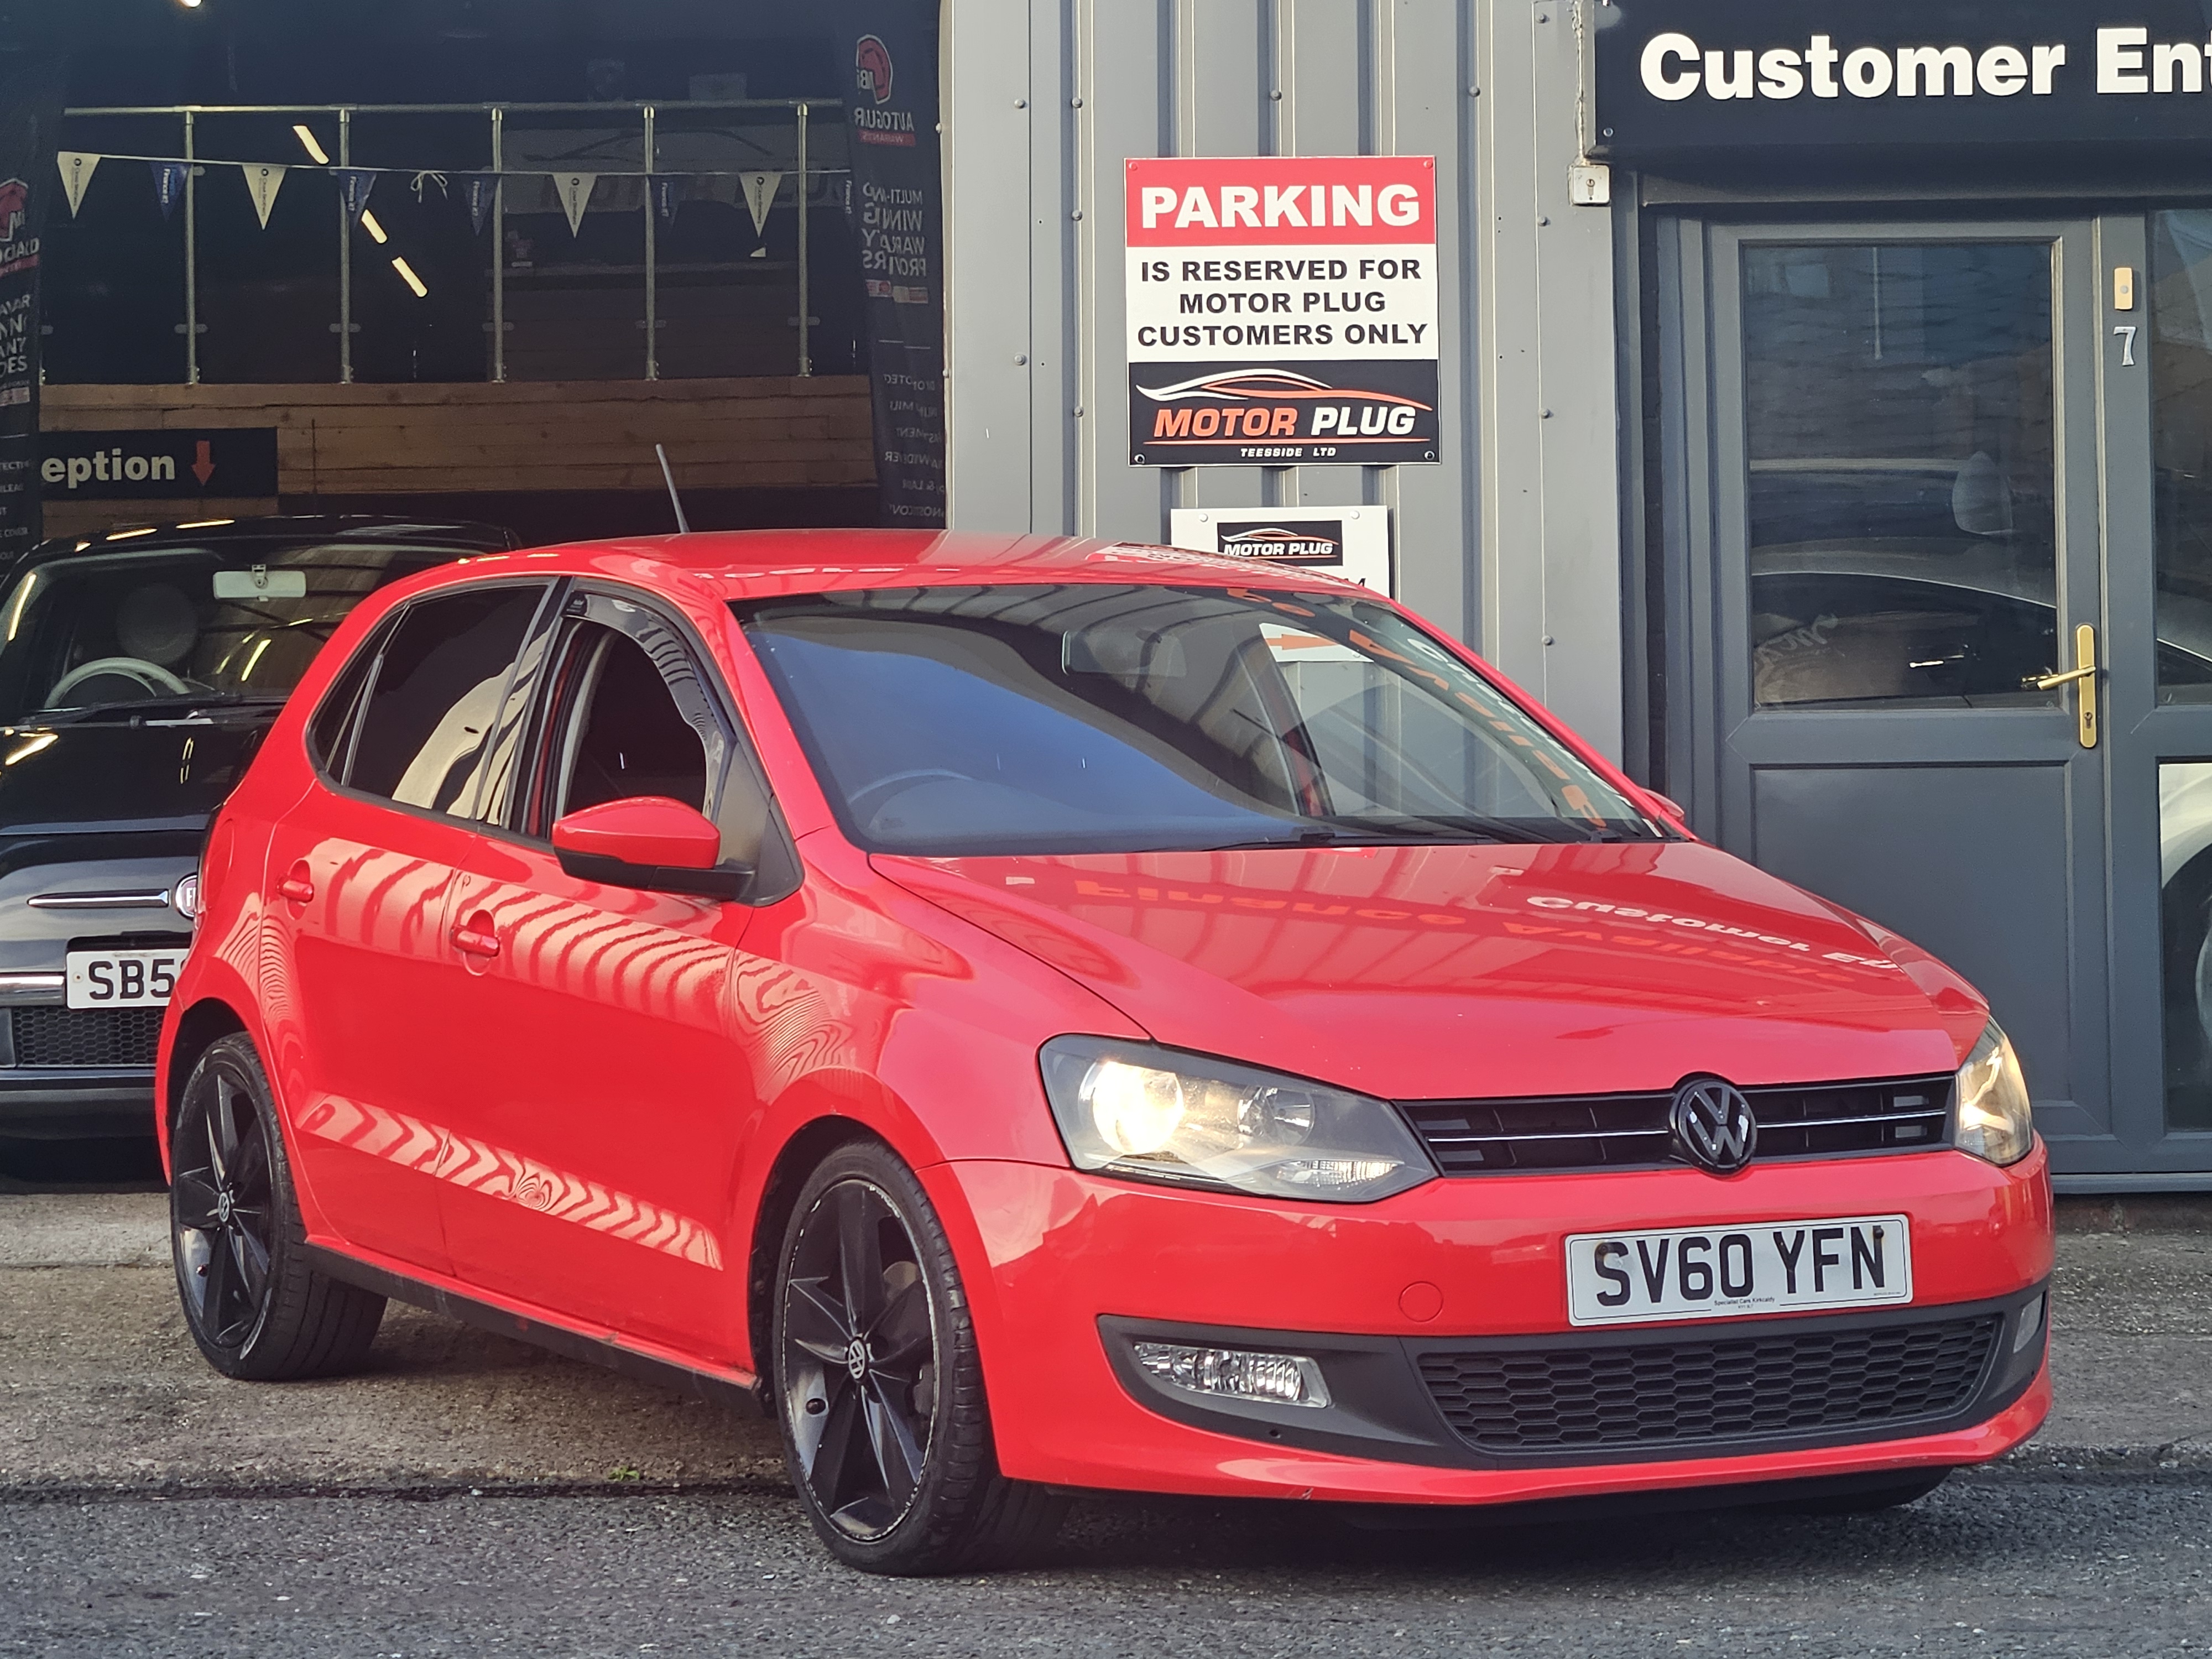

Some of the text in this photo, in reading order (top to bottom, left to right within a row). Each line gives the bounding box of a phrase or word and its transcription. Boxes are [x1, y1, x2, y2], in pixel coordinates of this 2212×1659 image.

[1640, 32, 2065, 100] Customer
[1141, 184, 1420, 228] PARKING
[1141, 259, 1422, 281] IS RESERVED FOR
[1180, 291, 1385, 314] MOTOR PLUG
[1138, 323, 1427, 347] CUSTOMERS ONLY
[2113, 326, 2137, 367] 7
[1154, 406, 1416, 437] MOTOR PLUG
[41, 447, 175, 489] eption
[1240, 447, 1336, 457] TEESSIDE LTD
[1223, 542, 1333, 556] MOTOR PLUG
[88, 958, 185, 1000] SB5
[1594, 1225, 1885, 1307] SV60 YFN
